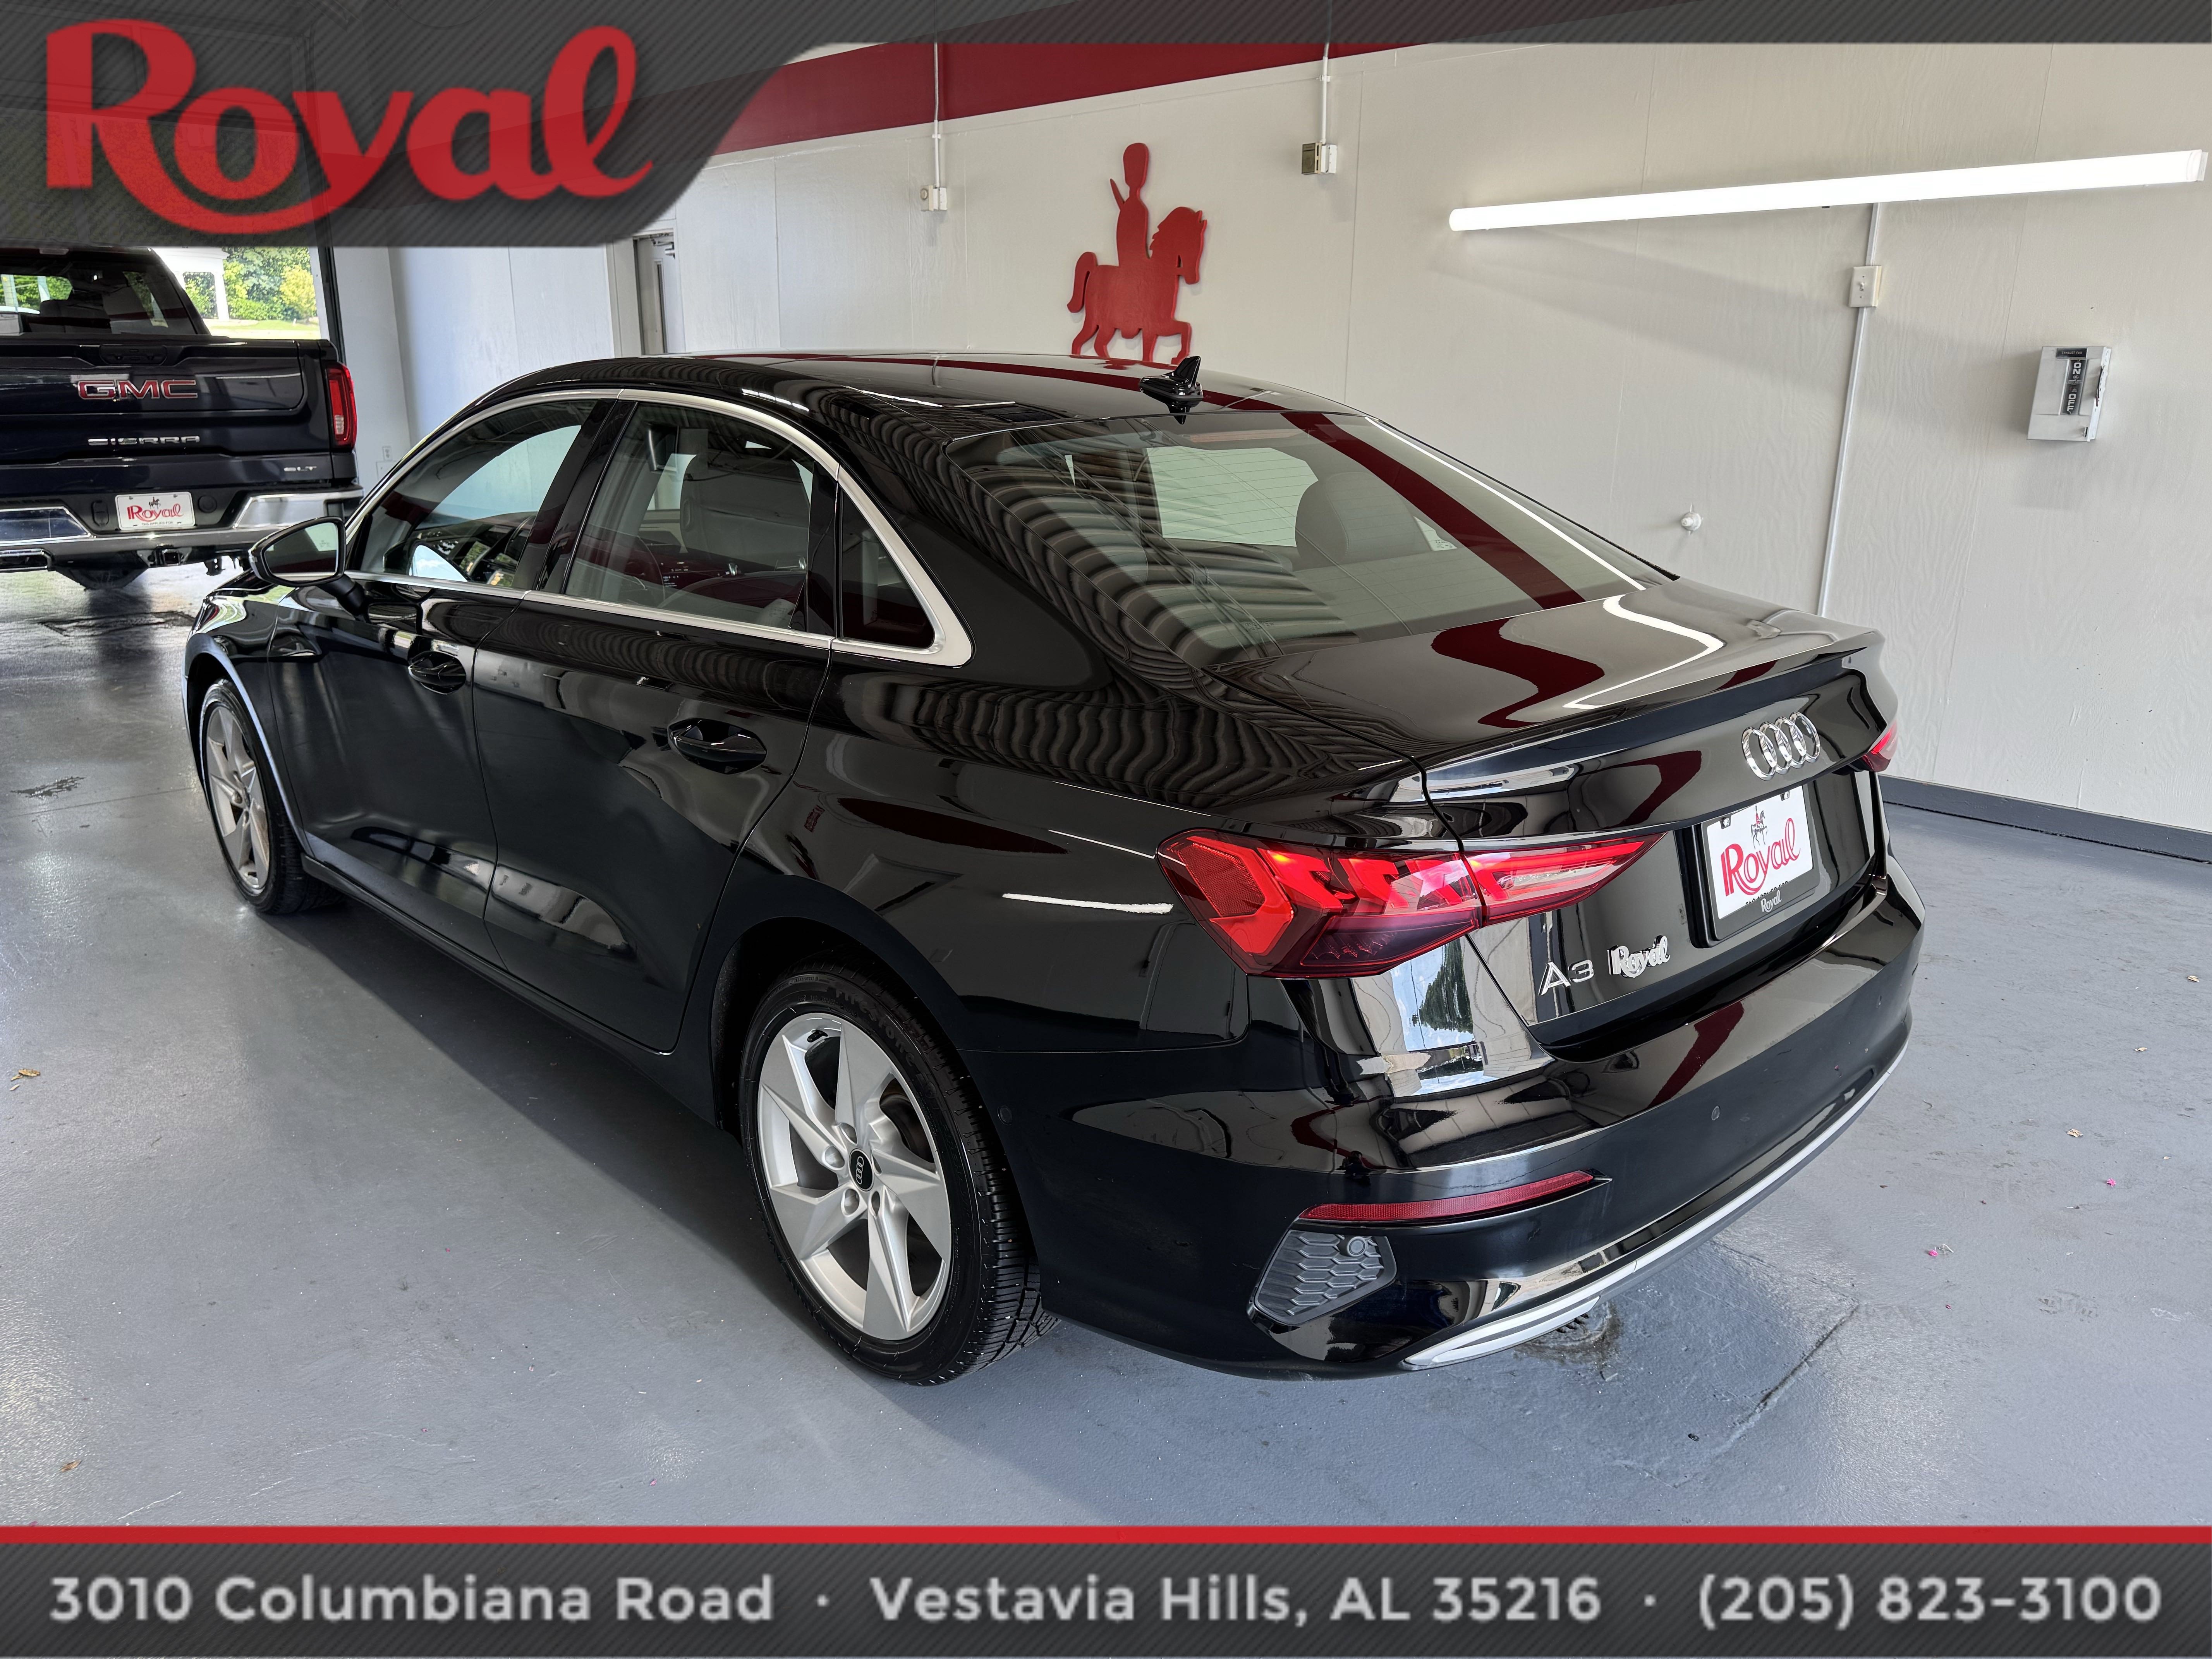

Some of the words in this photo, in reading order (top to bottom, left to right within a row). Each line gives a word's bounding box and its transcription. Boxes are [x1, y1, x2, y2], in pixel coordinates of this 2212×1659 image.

[2072, 362, 2082, 374] ON
[77, 380, 198, 400] GMC
[2066, 393, 2076, 412] OFF
[88, 435, 200, 446] SIERRA
[127, 503, 184, 522] Royal
[1721, 817, 1801, 897] Royal
[1760, 890, 1782, 913] Royal
[1607, 935, 1671, 979] Royal
[1538, 959, 1594, 996] A3
